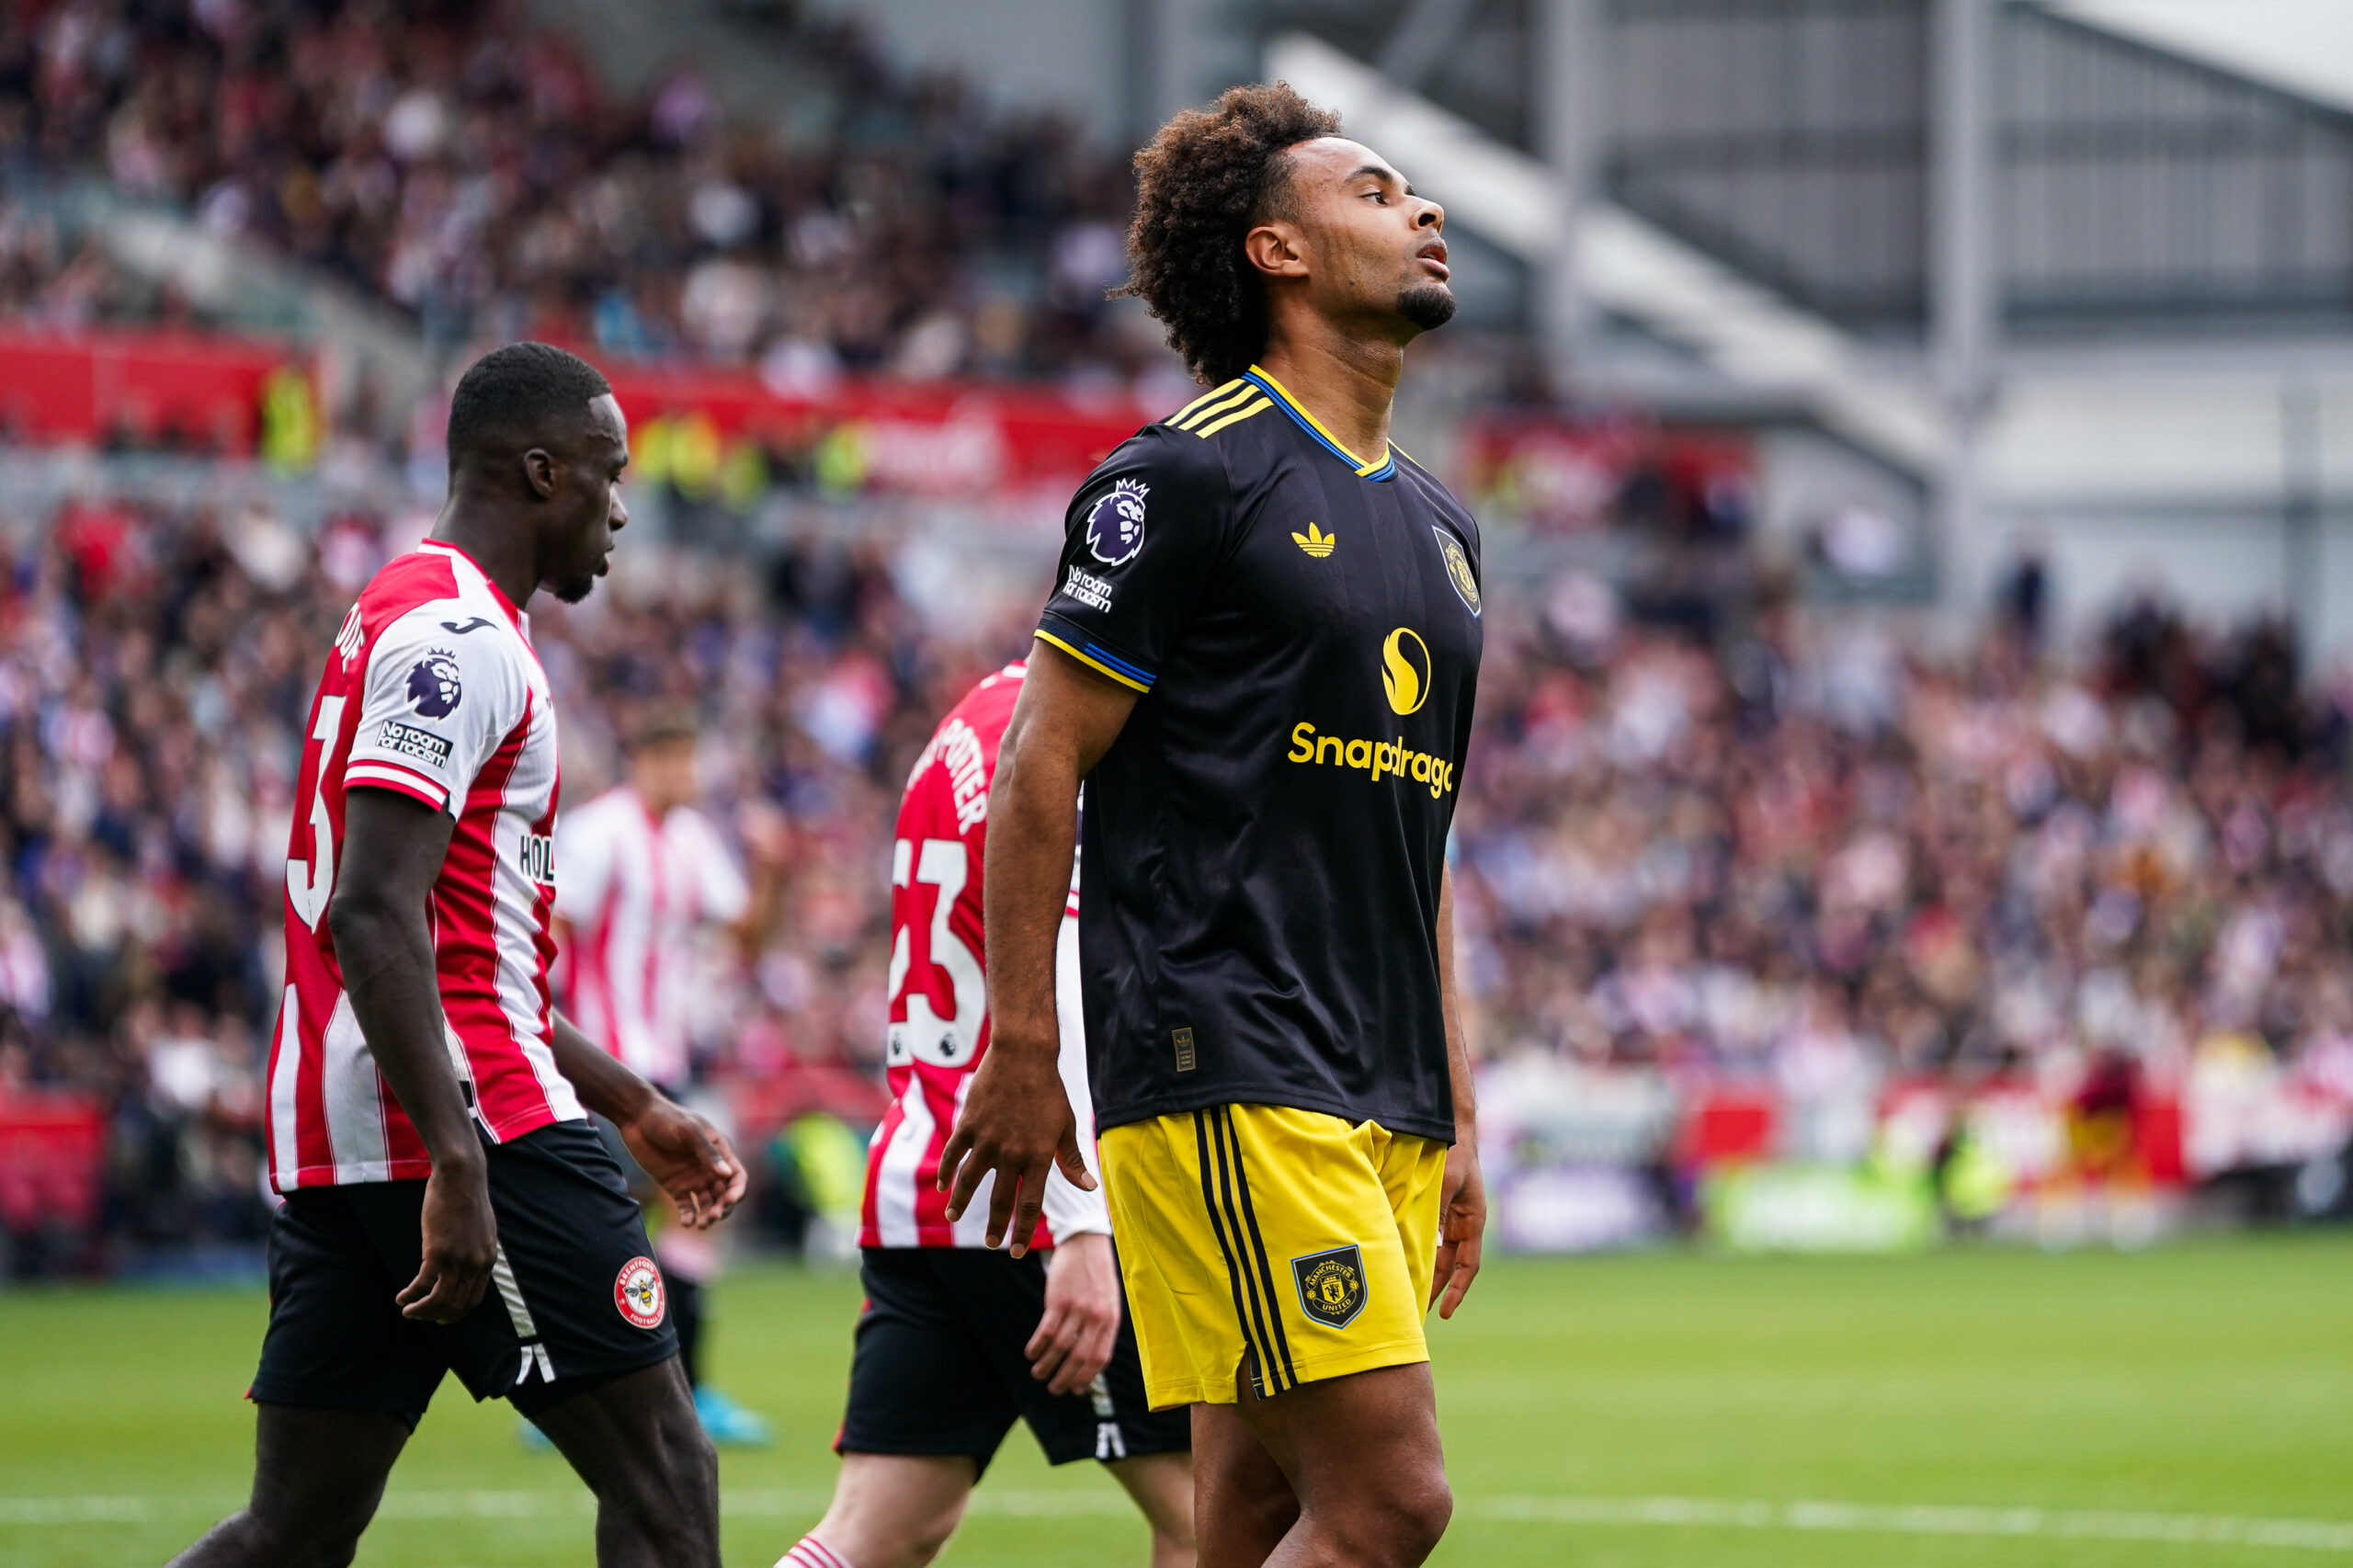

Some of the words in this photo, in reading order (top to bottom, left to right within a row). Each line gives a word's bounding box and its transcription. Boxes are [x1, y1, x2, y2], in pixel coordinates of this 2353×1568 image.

[1068, 564, 1081, 584] No
[1080, 572, 1112, 598] room
[1074, 585, 1112, 613] racism
[381, 720, 404, 738] No
[404, 727, 446, 754] room
[376, 735, 399, 749] for
[398, 742, 447, 768] racism
[520, 835, 554, 881] HOL
[619, 1259, 654, 1286] BRENTFORD
[1310, 1264, 1351, 1286] MANCHESTER
[630, 1312, 658, 1324] FOOTBALL
[1322, 1298, 1351, 1312] UNITED
